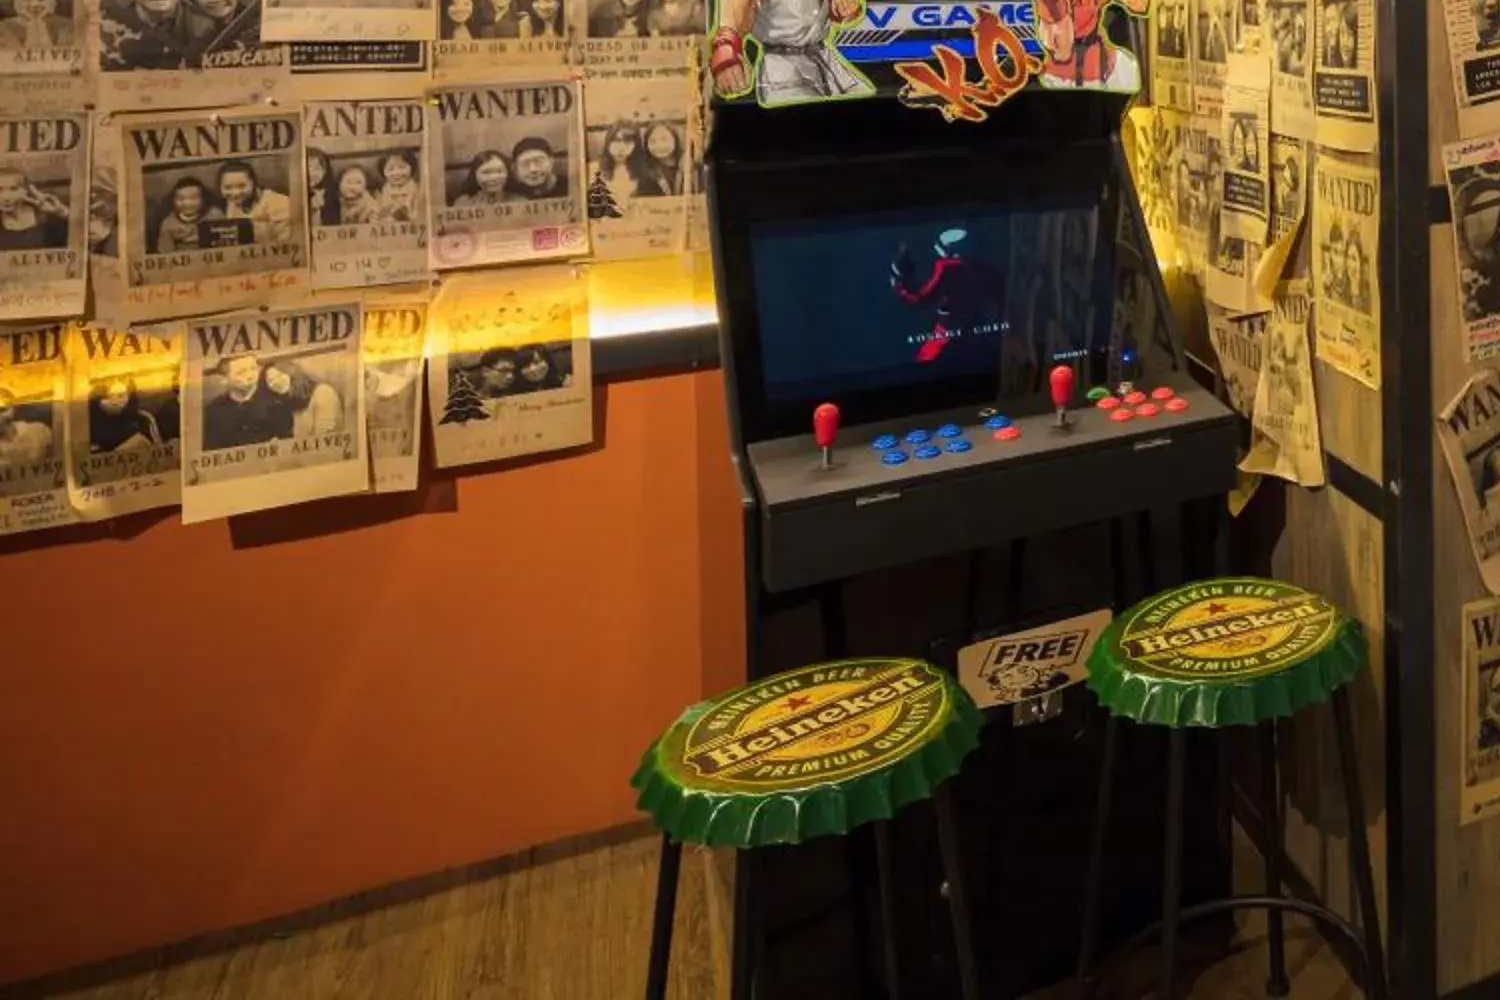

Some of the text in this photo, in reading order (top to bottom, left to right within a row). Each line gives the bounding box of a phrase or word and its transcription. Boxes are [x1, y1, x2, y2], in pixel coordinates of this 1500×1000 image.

[435, 86, 573, 121] WANTED
[131, 118, 296, 160] WANTED
[145, 256, 192, 270] DEAD
[202, 253, 224, 264] OR
[197, 311, 354, 356] WANTED
[200, 435, 341, 468] DEAD OR ALIVE
[1233, 585, 1277, 597] BEER
[994, 634, 1078, 664] FREE
[1139, 602, 1319, 654] Heineken
[1170, 624, 1320, 671] PREMIUM QUALITY
[707, 666, 868, 730] HEINEKEN BEER
[708, 671, 926, 768] Heineken
[754, 700, 930, 777] PREMIUM QUALITY
